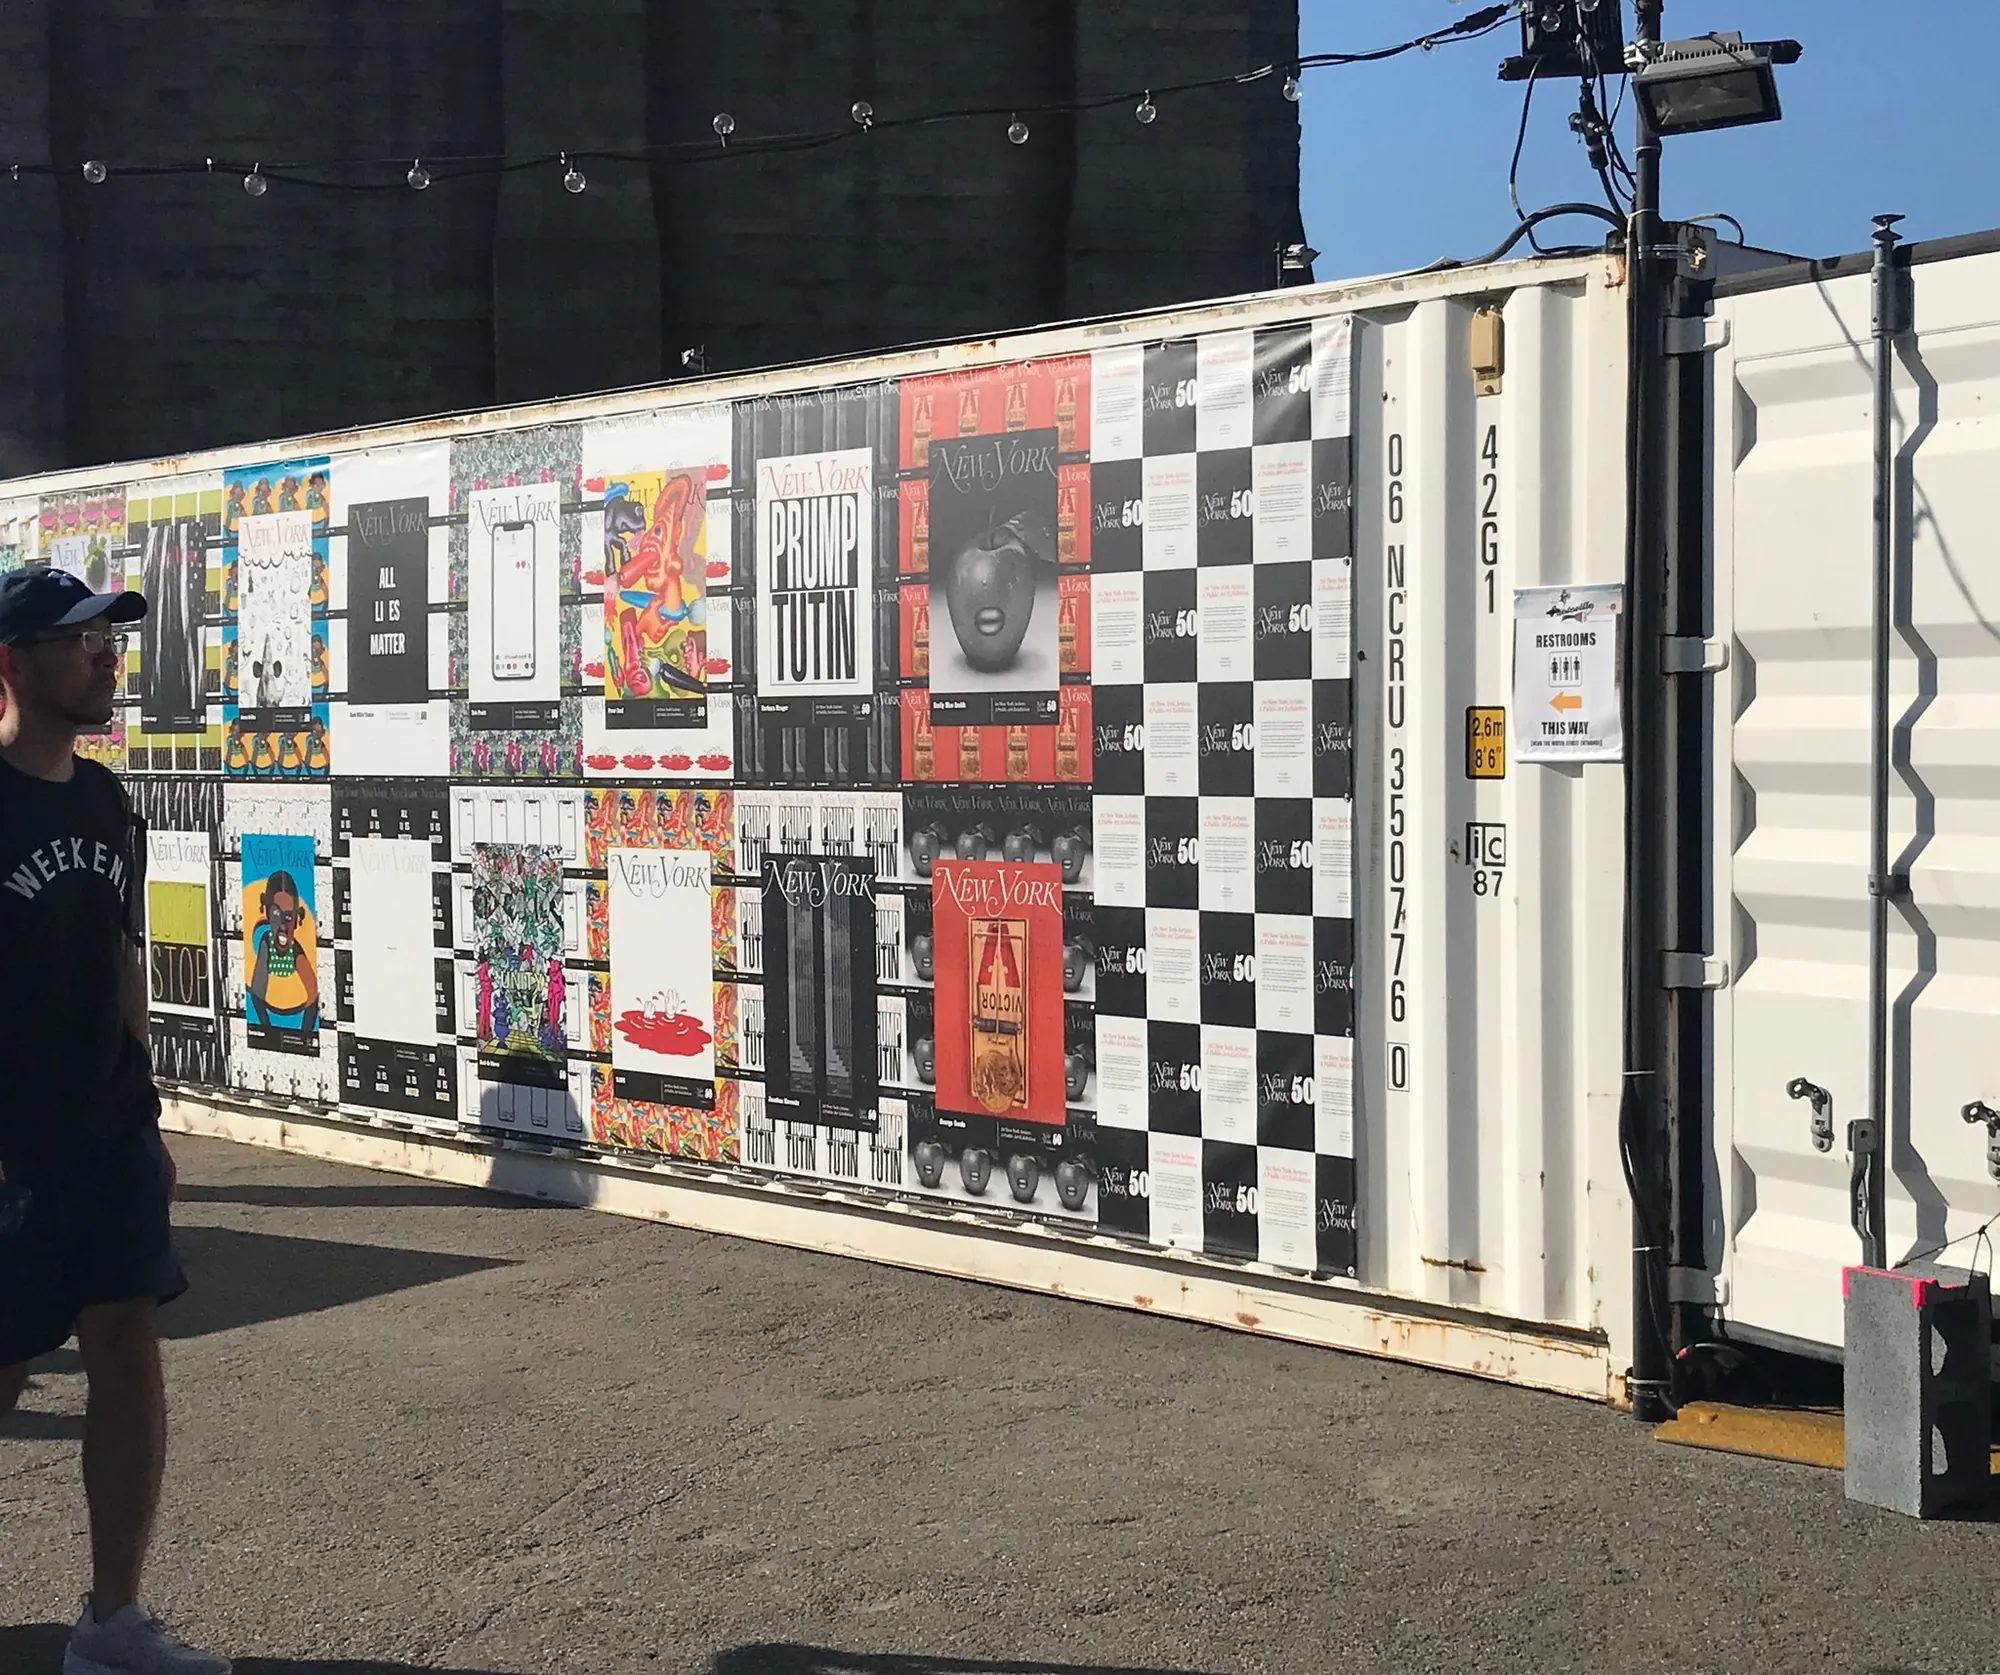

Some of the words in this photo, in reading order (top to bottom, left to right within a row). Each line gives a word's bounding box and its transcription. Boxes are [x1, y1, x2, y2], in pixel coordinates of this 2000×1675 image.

[1173, 378, 1196, 408] 50
[1286, 364, 1310, 395] 50
[930, 445, 991, 493] NEW
[982, 440, 1059, 491] YORK
[1121, 498, 1143, 526] 50
[1229, 488, 1253, 517] 50
[1481, 424, 1498, 614] 42G1
[771, 495, 857, 590] PRUMP
[379, 566, 396, 589] ALL
[1175, 608, 1198, 636] 50
[1287, 602, 1311, 632] 50
[370, 632, 406, 656] MATTER
[772, 590, 856, 682] TUTIN
[1387, 544, 1405, 728] NCRU
[1535, 632, 1596, 648] RESTROOMS
[1123, 724, 1145, 751] 50
[1231, 722, 1254, 750] 50
[1541, 721, 1566, 735] THIS
[1568, 721, 1589, 735] WAY
[739, 805, 770, 840] PRUMP
[779, 806, 811, 841] PRUMP
[821, 807, 854, 842] PRUMP
[864, 808, 897, 843] PRUMP
[1177, 837, 1199, 864] 50
[1289, 839, 1313, 868] 50
[608, 855, 657, 897] NEW
[650, 856, 711, 898] YORK
[761, 860, 816, 907] NEW
[809, 862, 876, 908] YORK
[1390, 747, 1406, 1022] 350776
[1473, 869, 1503, 897] 87
[932, 867, 995, 916] NEW
[986, 869, 1062, 917] YORK
[152, 945, 208, 1005] STOP
[1125, 947, 1147, 975] 50
[1233, 953, 1256, 982] 50
[502, 970, 545, 991] UNITY
[982, 992, 1023, 1013] VICTOR
[1179, 1062, 1201, 1091] 50
[1290, 1073, 1314, 1102] 50
[745, 1130, 775, 1165] TUTIN
[786, 1135, 816, 1171] TUTIN
[827, 1140, 858, 1178] TUTIN
[870, 1146, 901, 1185] TUTIN
[1127, 1168, 1149, 1196] 50
[1234, 1181, 1257, 1211] 50
